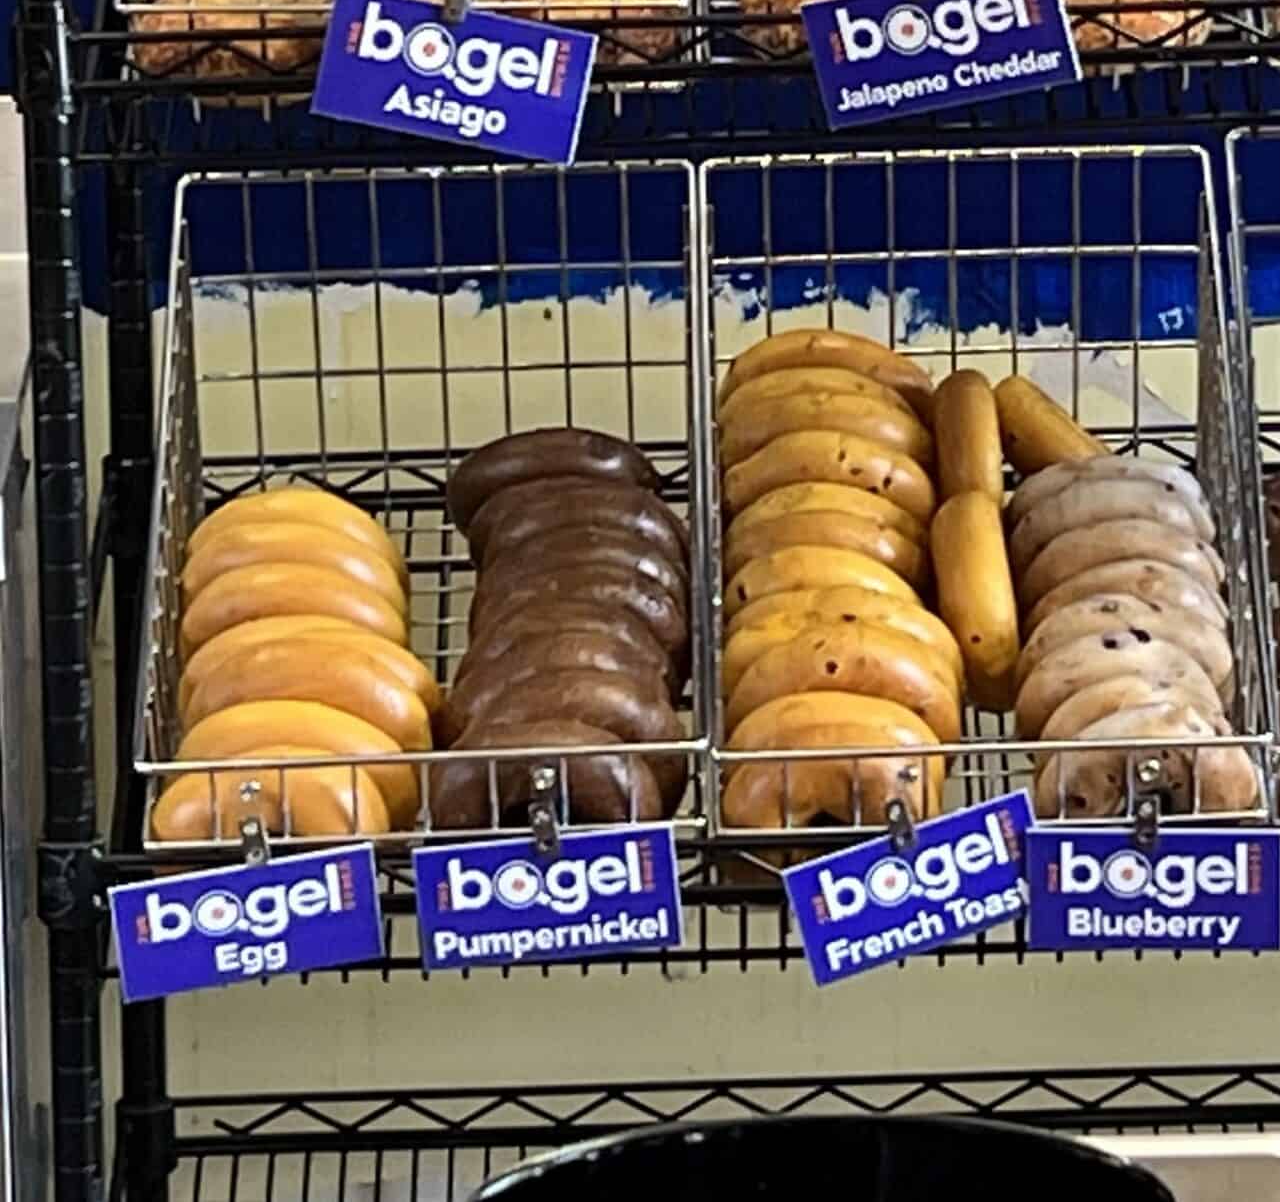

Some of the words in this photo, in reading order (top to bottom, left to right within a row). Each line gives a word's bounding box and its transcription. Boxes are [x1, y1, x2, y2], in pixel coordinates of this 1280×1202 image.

[837, 73, 949, 112] Jalapeno
[953, 49, 1062, 88] Cheddar
[383, 83, 507, 138] Asiago
[433, 907, 669, 960] Pumpernickel
[825, 909, 946, 972] French
[944, 877, 1030, 930] Toast
[1067, 907, 1242, 945] Blueberry
[214, 940, 289, 975] Egg
